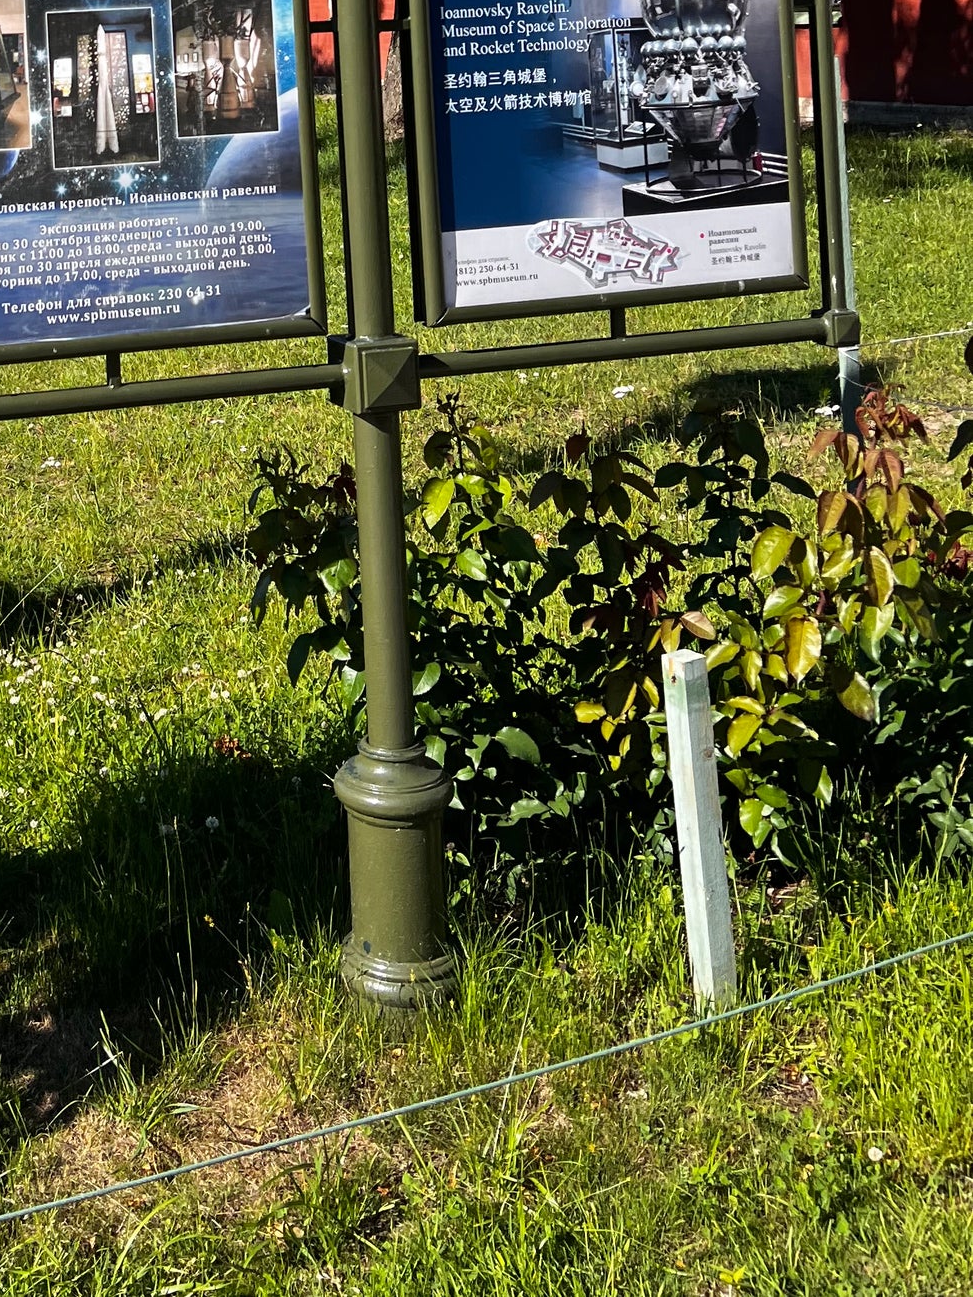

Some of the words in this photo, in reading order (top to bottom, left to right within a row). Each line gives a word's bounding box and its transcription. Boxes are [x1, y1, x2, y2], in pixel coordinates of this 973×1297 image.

[440, 3, 513, 20] Ioannovsky
[517, 0, 570, 16] Ravelin.
[441, 24, 496, 39] Museum
[500, 21, 515, 35] of
[517, 20, 555, 36] Space
[558, 17, 632, 34] Exploration
[443, 42, 467, 57] and
[470, 40, 515, 56] Rocket
[517, 36, 592, 53] Technology
[445, 89, 592, 115] 太空及火箭技术博物馆
[60, 195, 126, 213] крепость,
[129, 187, 218, 204] Иоанновский
[222, 184, 277, 200] равелин
[13, 238, 28, 250] 30
[32, 234, 91, 249] сентября
[94, 229, 163, 245] ежедневно
[166, 229, 173, 238] с
[176, 224, 208, 237] 11.00
[211, 224, 226, 236] до
[230, 220, 266, 233] 19.00,
[40, 221, 115, 236] Экспозиция
[119, 217, 179, 231] работает:
[18, 263, 33, 274] по
[37, 261, 53, 273] 30
[56, 258, 101, 274] апреля
[104, 252, 173, 268] ежедневно
[176, 252, 182, 260] с
[186, 247, 219, 260] 11.00
[221, 247, 236, 259] до
[240, 243, 276, 256] 18.00,
[20, 252, 26, 261] с
[30, 248, 64, 261] 11.00
[67, 248, 83, 260] до
[87, 243, 124, 257] 18.00,
[127, 240, 162, 253] среда
[175, 233, 236, 250] выходной
[239, 233, 272, 245] день;
[45, 274, 60, 286] до
[64, 270, 102, 283] 17.00,
[105, 266, 140, 281] среда
[153, 259, 215, 276] выходной
[218, 258, 251, 271] день.
[455, 266, 477, 276] (812)
[455, 273, 538, 286] www.spbmuseum.ru
[2, 300, 62, 315] Телефон
[66, 297, 91, 312] для
[95, 292, 154, 308] справок:
[158, 287, 182, 301] 230
[186, 286, 202, 299] 64
[205, 284, 222, 297] 31
[46, 303, 181, 325] www.spbmuseum.ru
